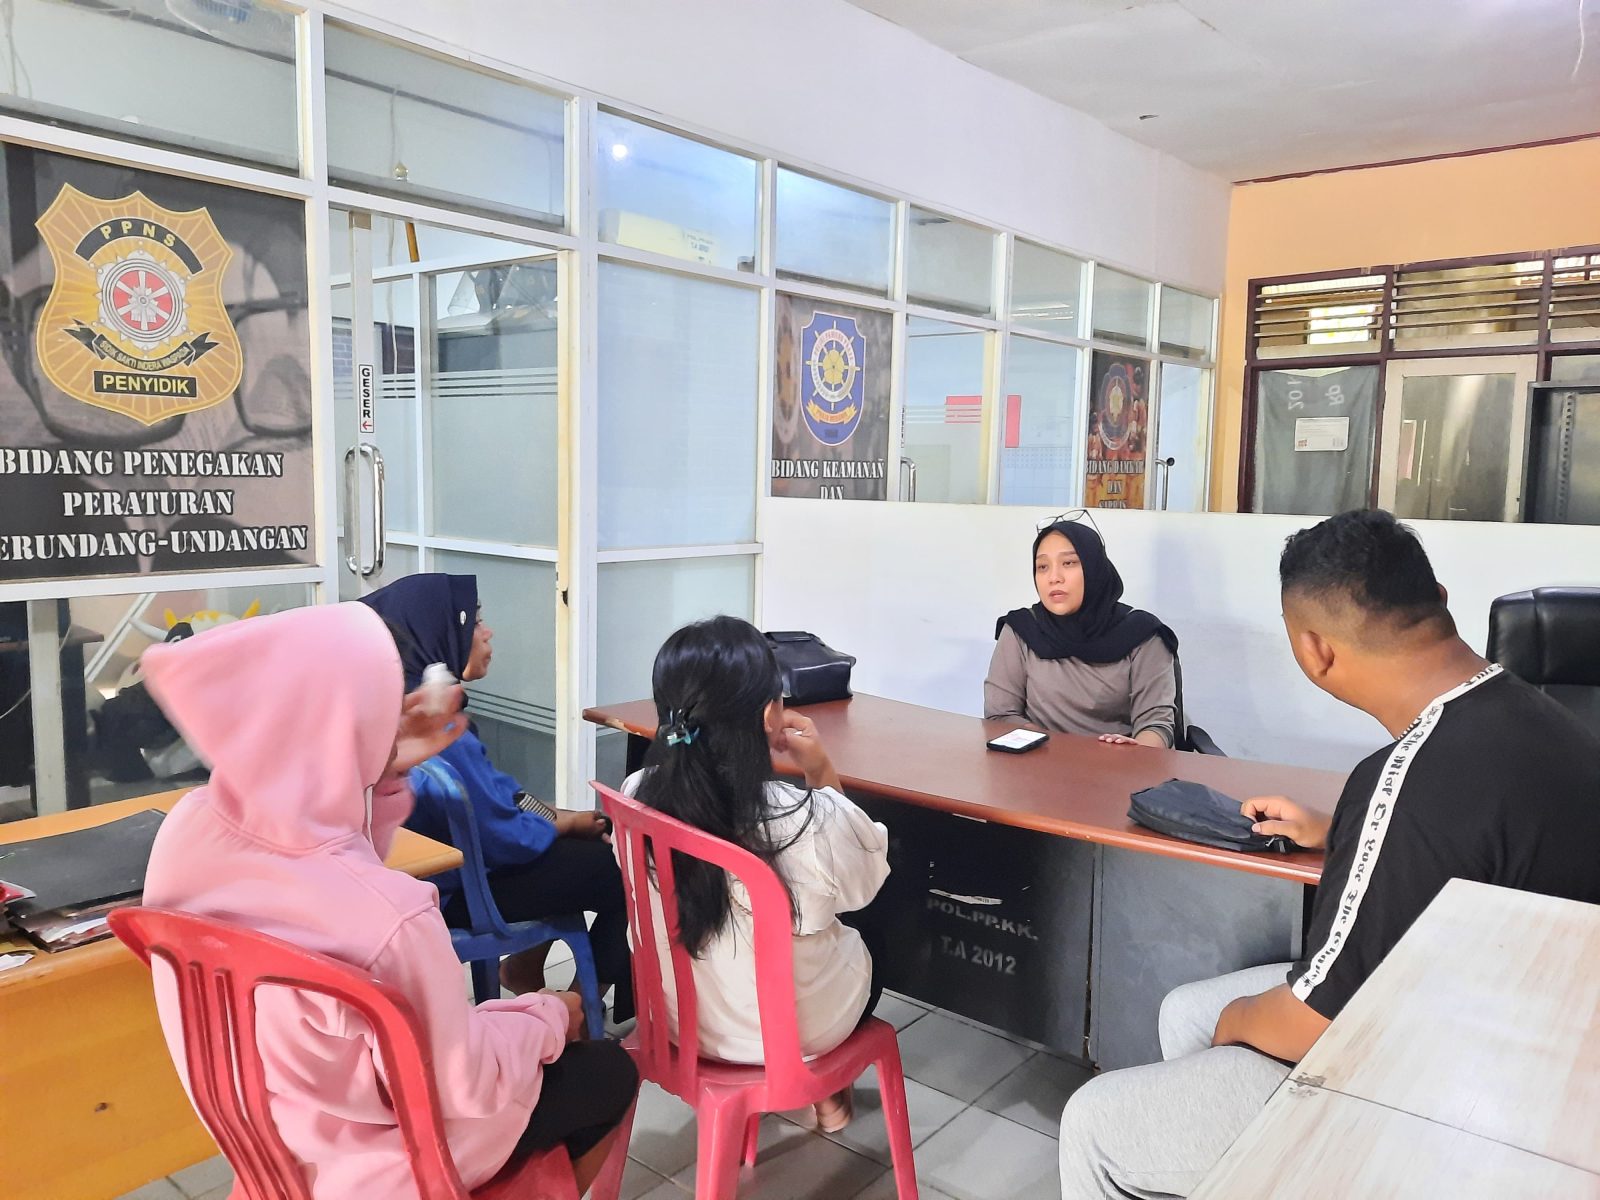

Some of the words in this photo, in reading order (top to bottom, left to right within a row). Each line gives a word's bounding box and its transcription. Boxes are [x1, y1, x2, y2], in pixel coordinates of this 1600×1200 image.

[100, 220, 176, 247] PPNS
[102, 374, 190, 394] PENYIDIK
[361, 367, 371, 418] GESER
[0, 448, 113, 475] BIDANG
[124, 452, 283, 476] PENEGAKAN
[770, 459, 819, 478] BIDANG
[62, 491, 234, 517] PERATURAN
[820, 486, 844, 500] DAN
[971, 945, 1017, 975] 2012
